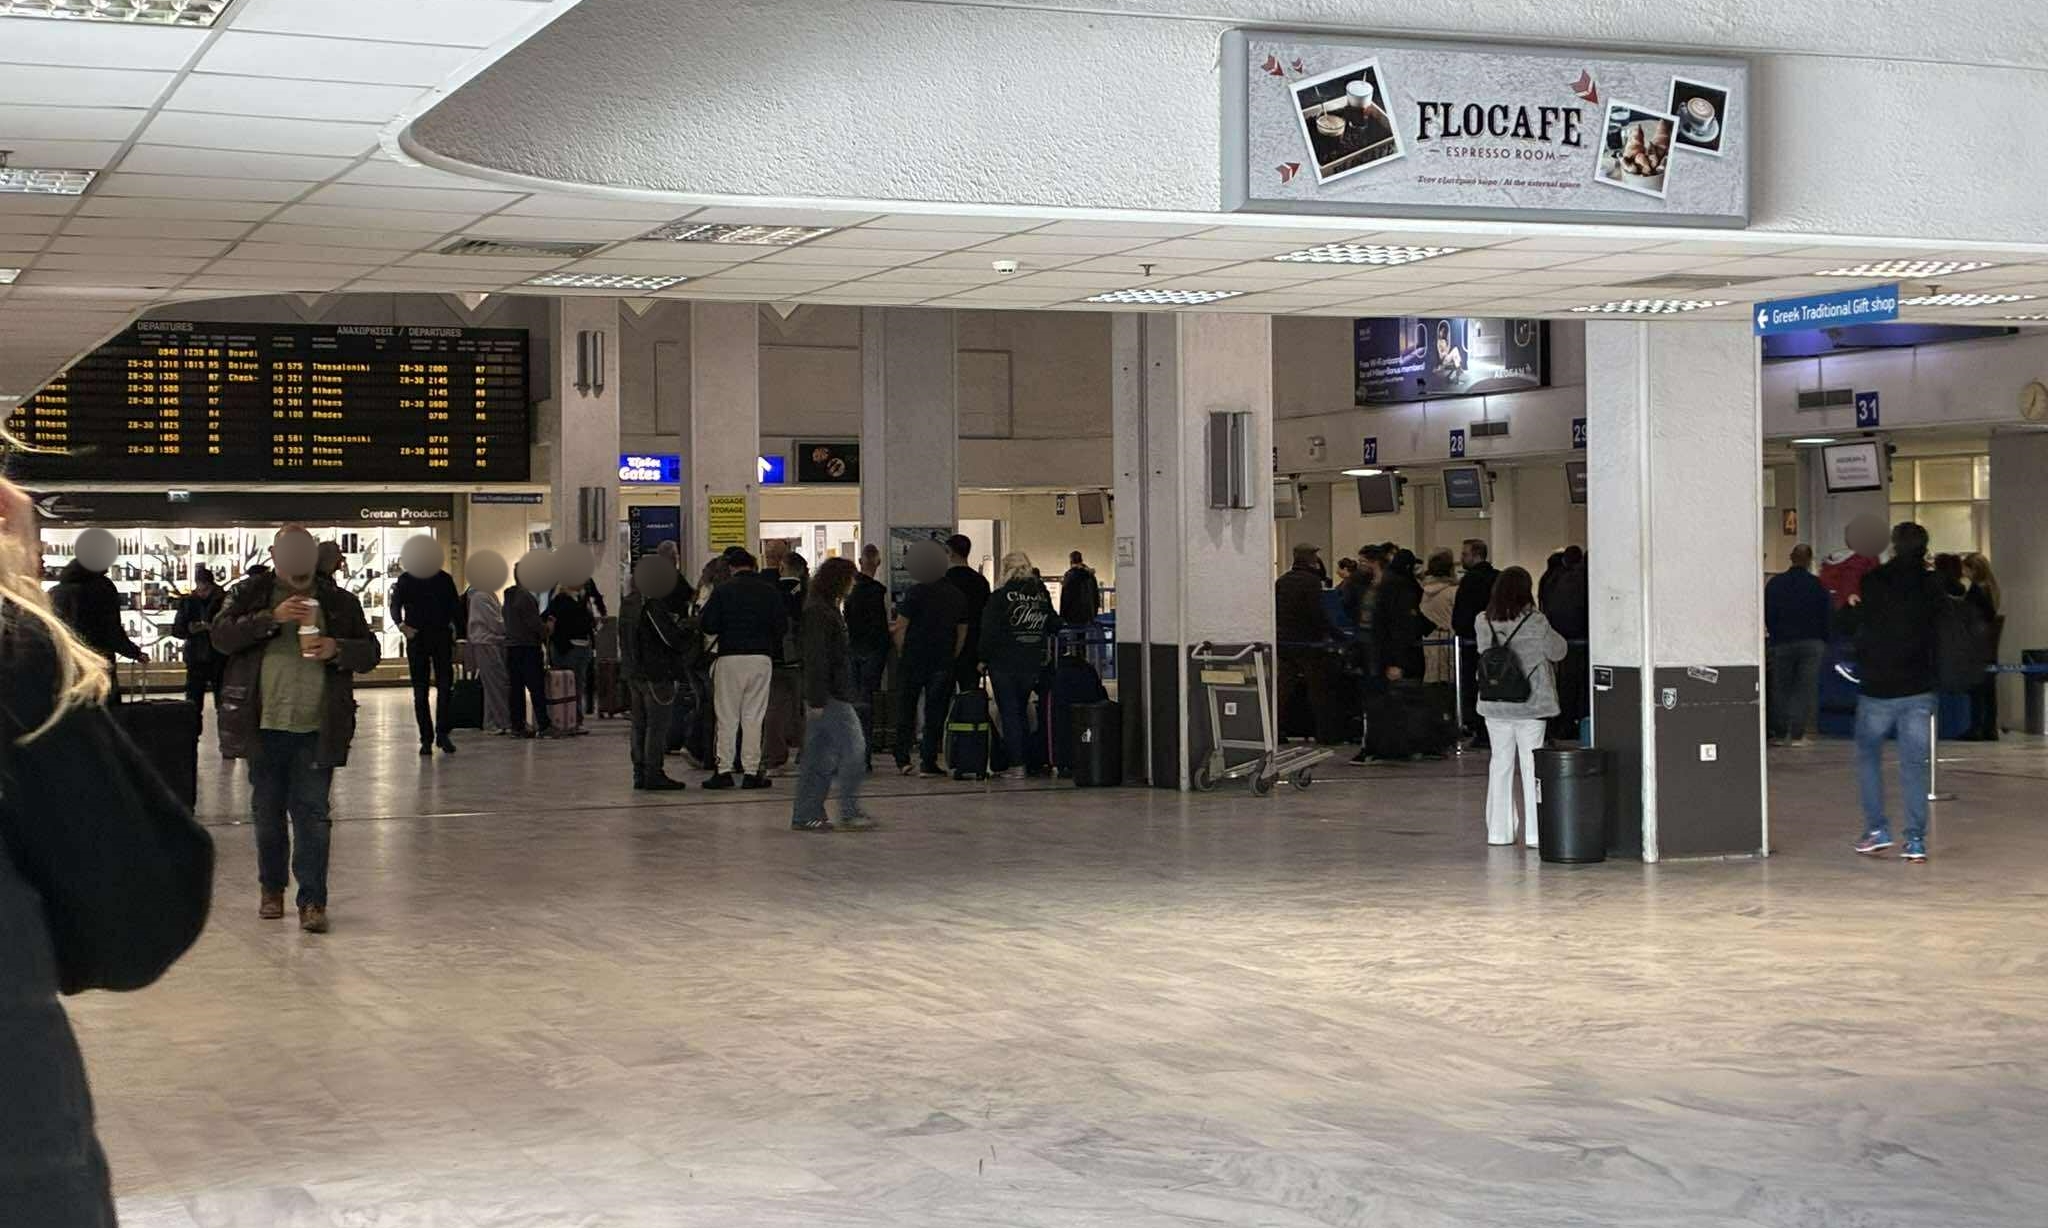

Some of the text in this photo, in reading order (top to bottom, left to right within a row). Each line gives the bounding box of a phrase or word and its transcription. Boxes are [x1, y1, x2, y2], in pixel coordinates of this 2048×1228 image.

[1416, 101, 1583, 147] FLOCAFE
[1447, 147, 1556, 160] ESPRESSO ROOM
[1513, 178, 1526, 187] the
[1527, 180, 1558, 189] external
[1558, 181, 1581, 190] space
[1773, 296, 1896, 324] Greek Traditional Gift shop
[137, 322, 194, 332] DEPARTURES
[408, 328, 463, 337] DEPARTURES
[313, 363, 369, 371] Thessaloniki
[1859, 398, 1878, 420] 31
[1451, 435, 1464, 452] 28
[1365, 443, 1376, 459] 27
[619, 467, 660, 480] Gates
[360, 508, 449, 519] Cretan Products
